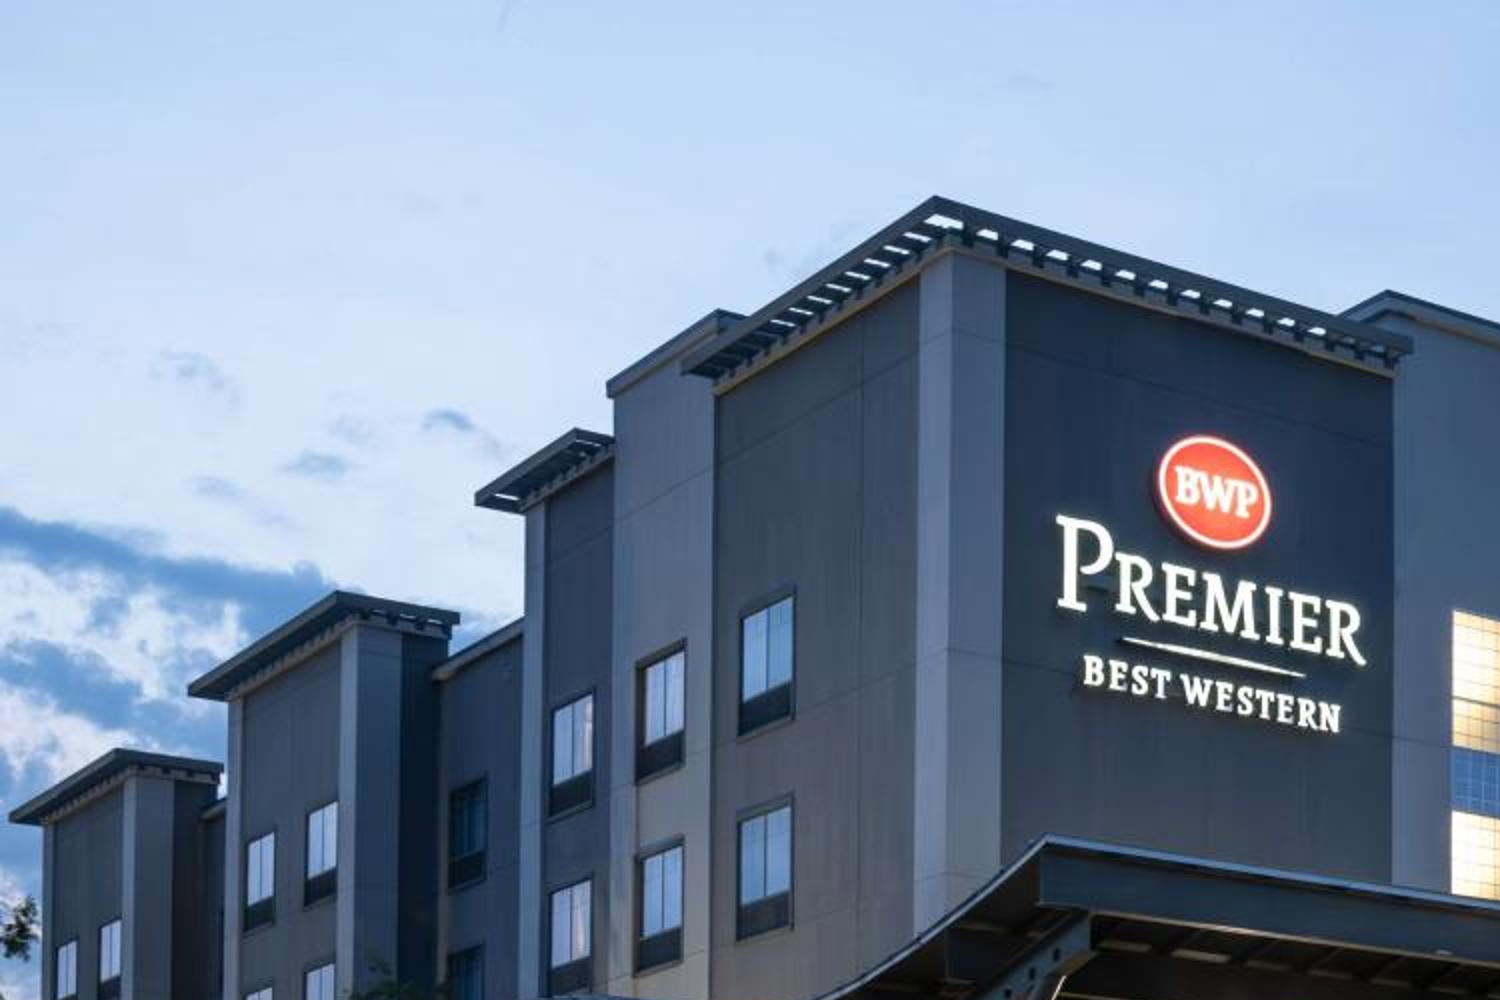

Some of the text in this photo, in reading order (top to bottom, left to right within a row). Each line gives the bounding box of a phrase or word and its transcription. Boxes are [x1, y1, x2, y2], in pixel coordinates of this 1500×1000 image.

[1174, 464, 1260, 519] BWP
[1055, 513, 1368, 667] PREMIER
[1083, 654, 1342, 734] BEST WESTERN
